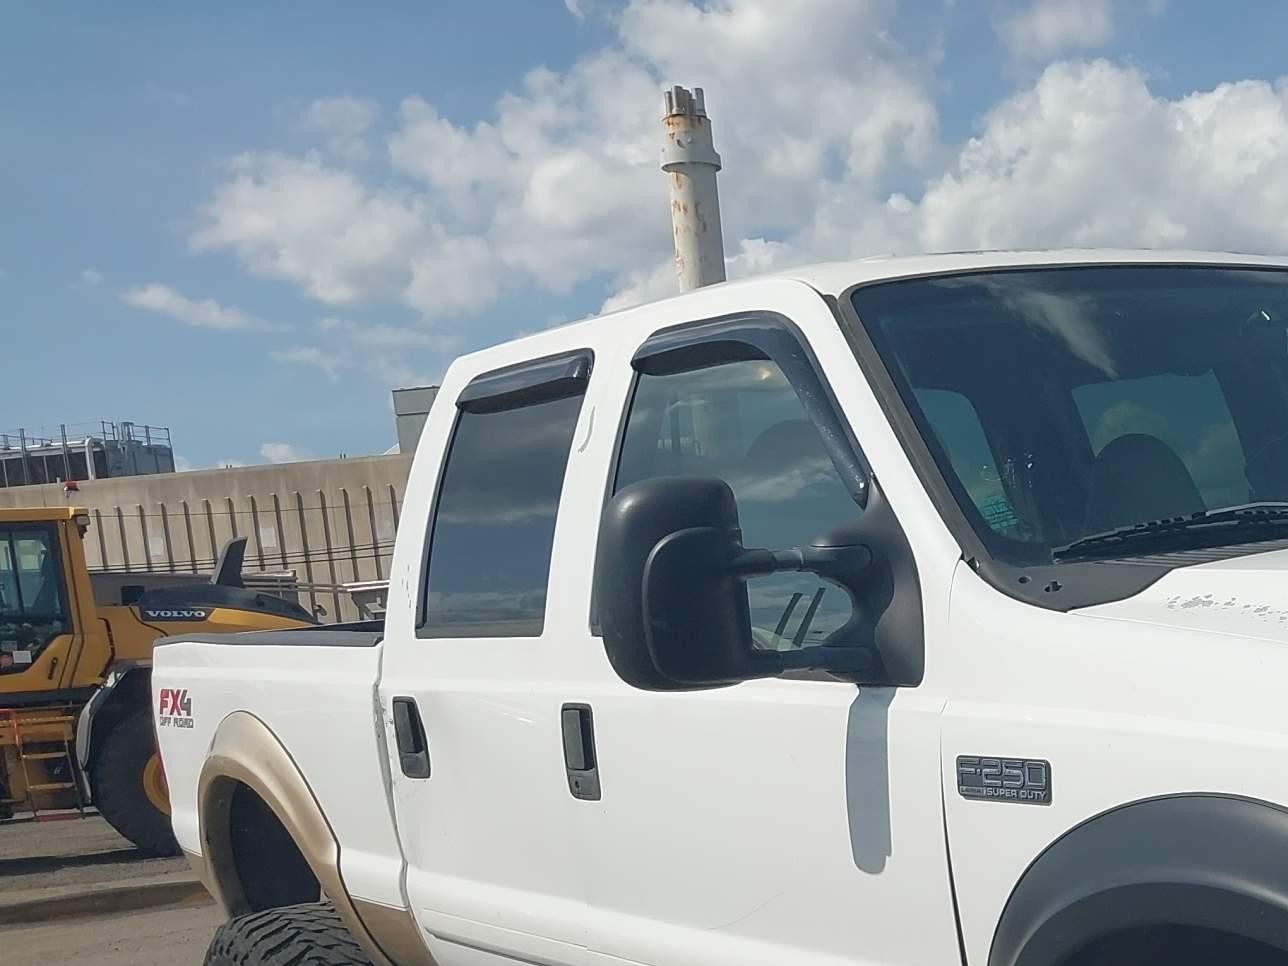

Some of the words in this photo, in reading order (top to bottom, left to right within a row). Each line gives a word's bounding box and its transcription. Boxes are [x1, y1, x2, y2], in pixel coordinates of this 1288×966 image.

[160, 688, 191, 716] FX4
[160, 716, 171, 727] OFF
[173, 717, 194, 729] ROAD
[987, 787, 1017, 798] SUPER
[1020, 790, 1047, 801] DUTY
